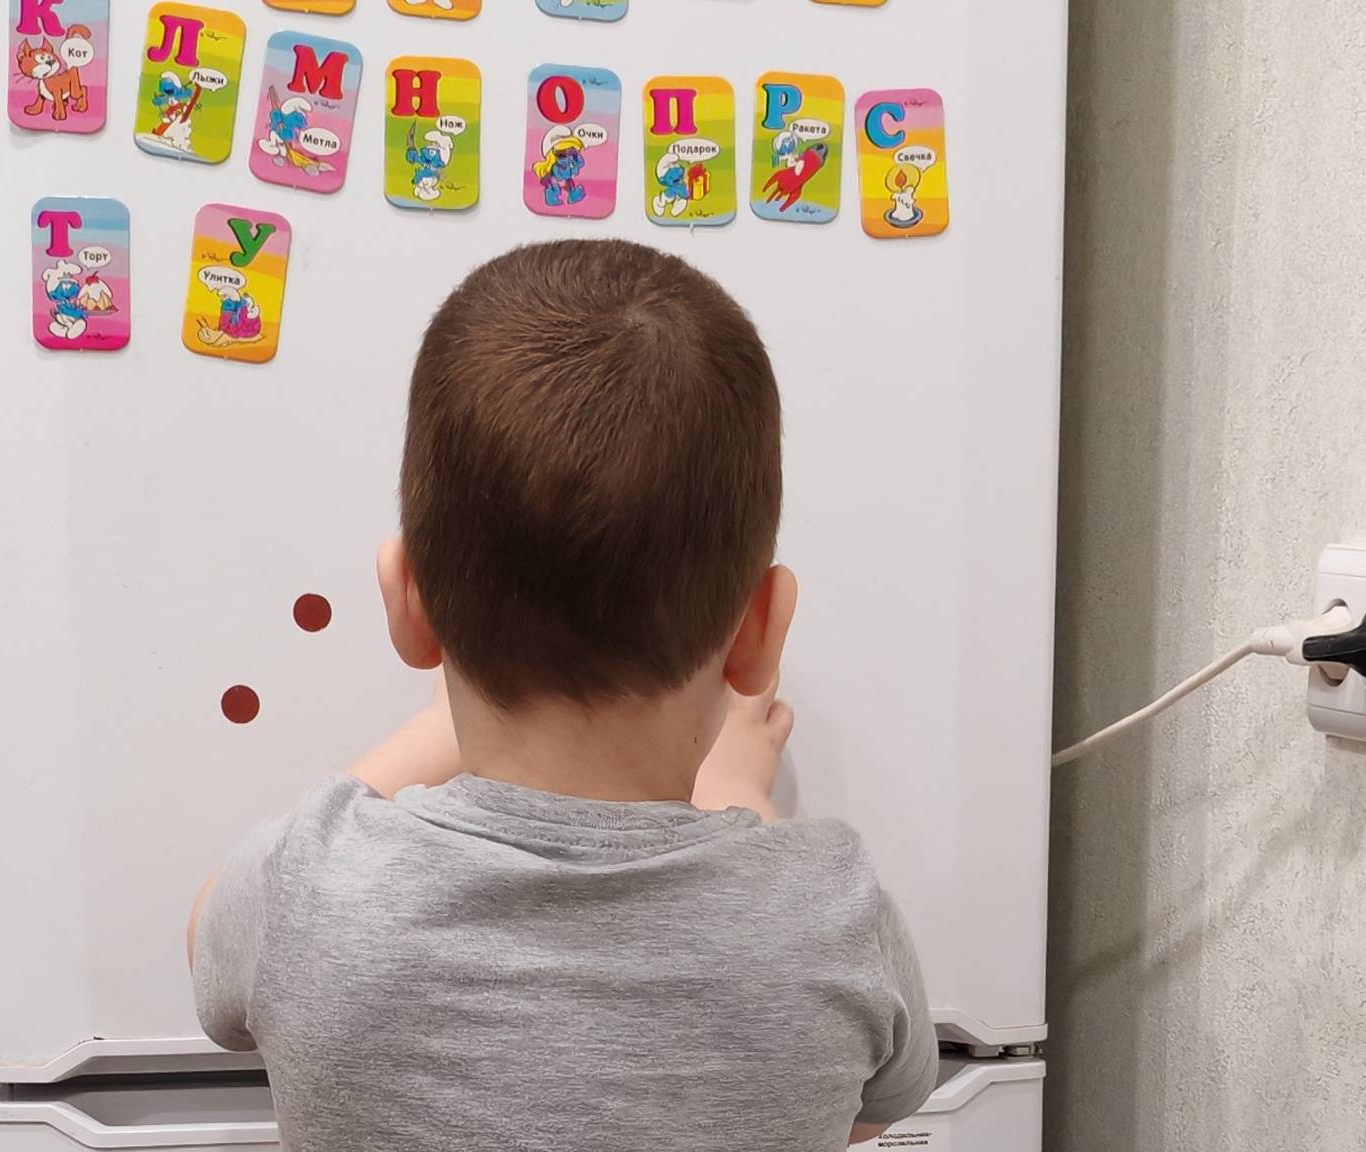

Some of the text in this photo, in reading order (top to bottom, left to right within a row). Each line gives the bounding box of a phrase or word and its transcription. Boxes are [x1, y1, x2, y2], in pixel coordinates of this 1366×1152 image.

[147, 15, 204, 67] Л
[67, 47, 88, 58] Кот
[191, 70, 225, 86] Лыжи
[288, 45, 349, 100] М
[391, 68, 441, 118] Н
[536, 75, 585, 124] О
[650, 88, 698, 136] П
[761, 83, 802, 129] Р
[439, 118, 463, 130] Нож
[792, 123, 827, 135] Ракета
[865, 101, 906, 149] С
[302, 133, 338, 149] Метла
[577, 128, 603, 139] Очки
[672, 143, 718, 156] Подарок
[897, 152, 932, 163] Свечка
[37, 211, 82, 258] Т
[227, 218, 277, 268] У
[83, 250, 108, 263] Торт
[203, 270, 241, 286] Улитка
